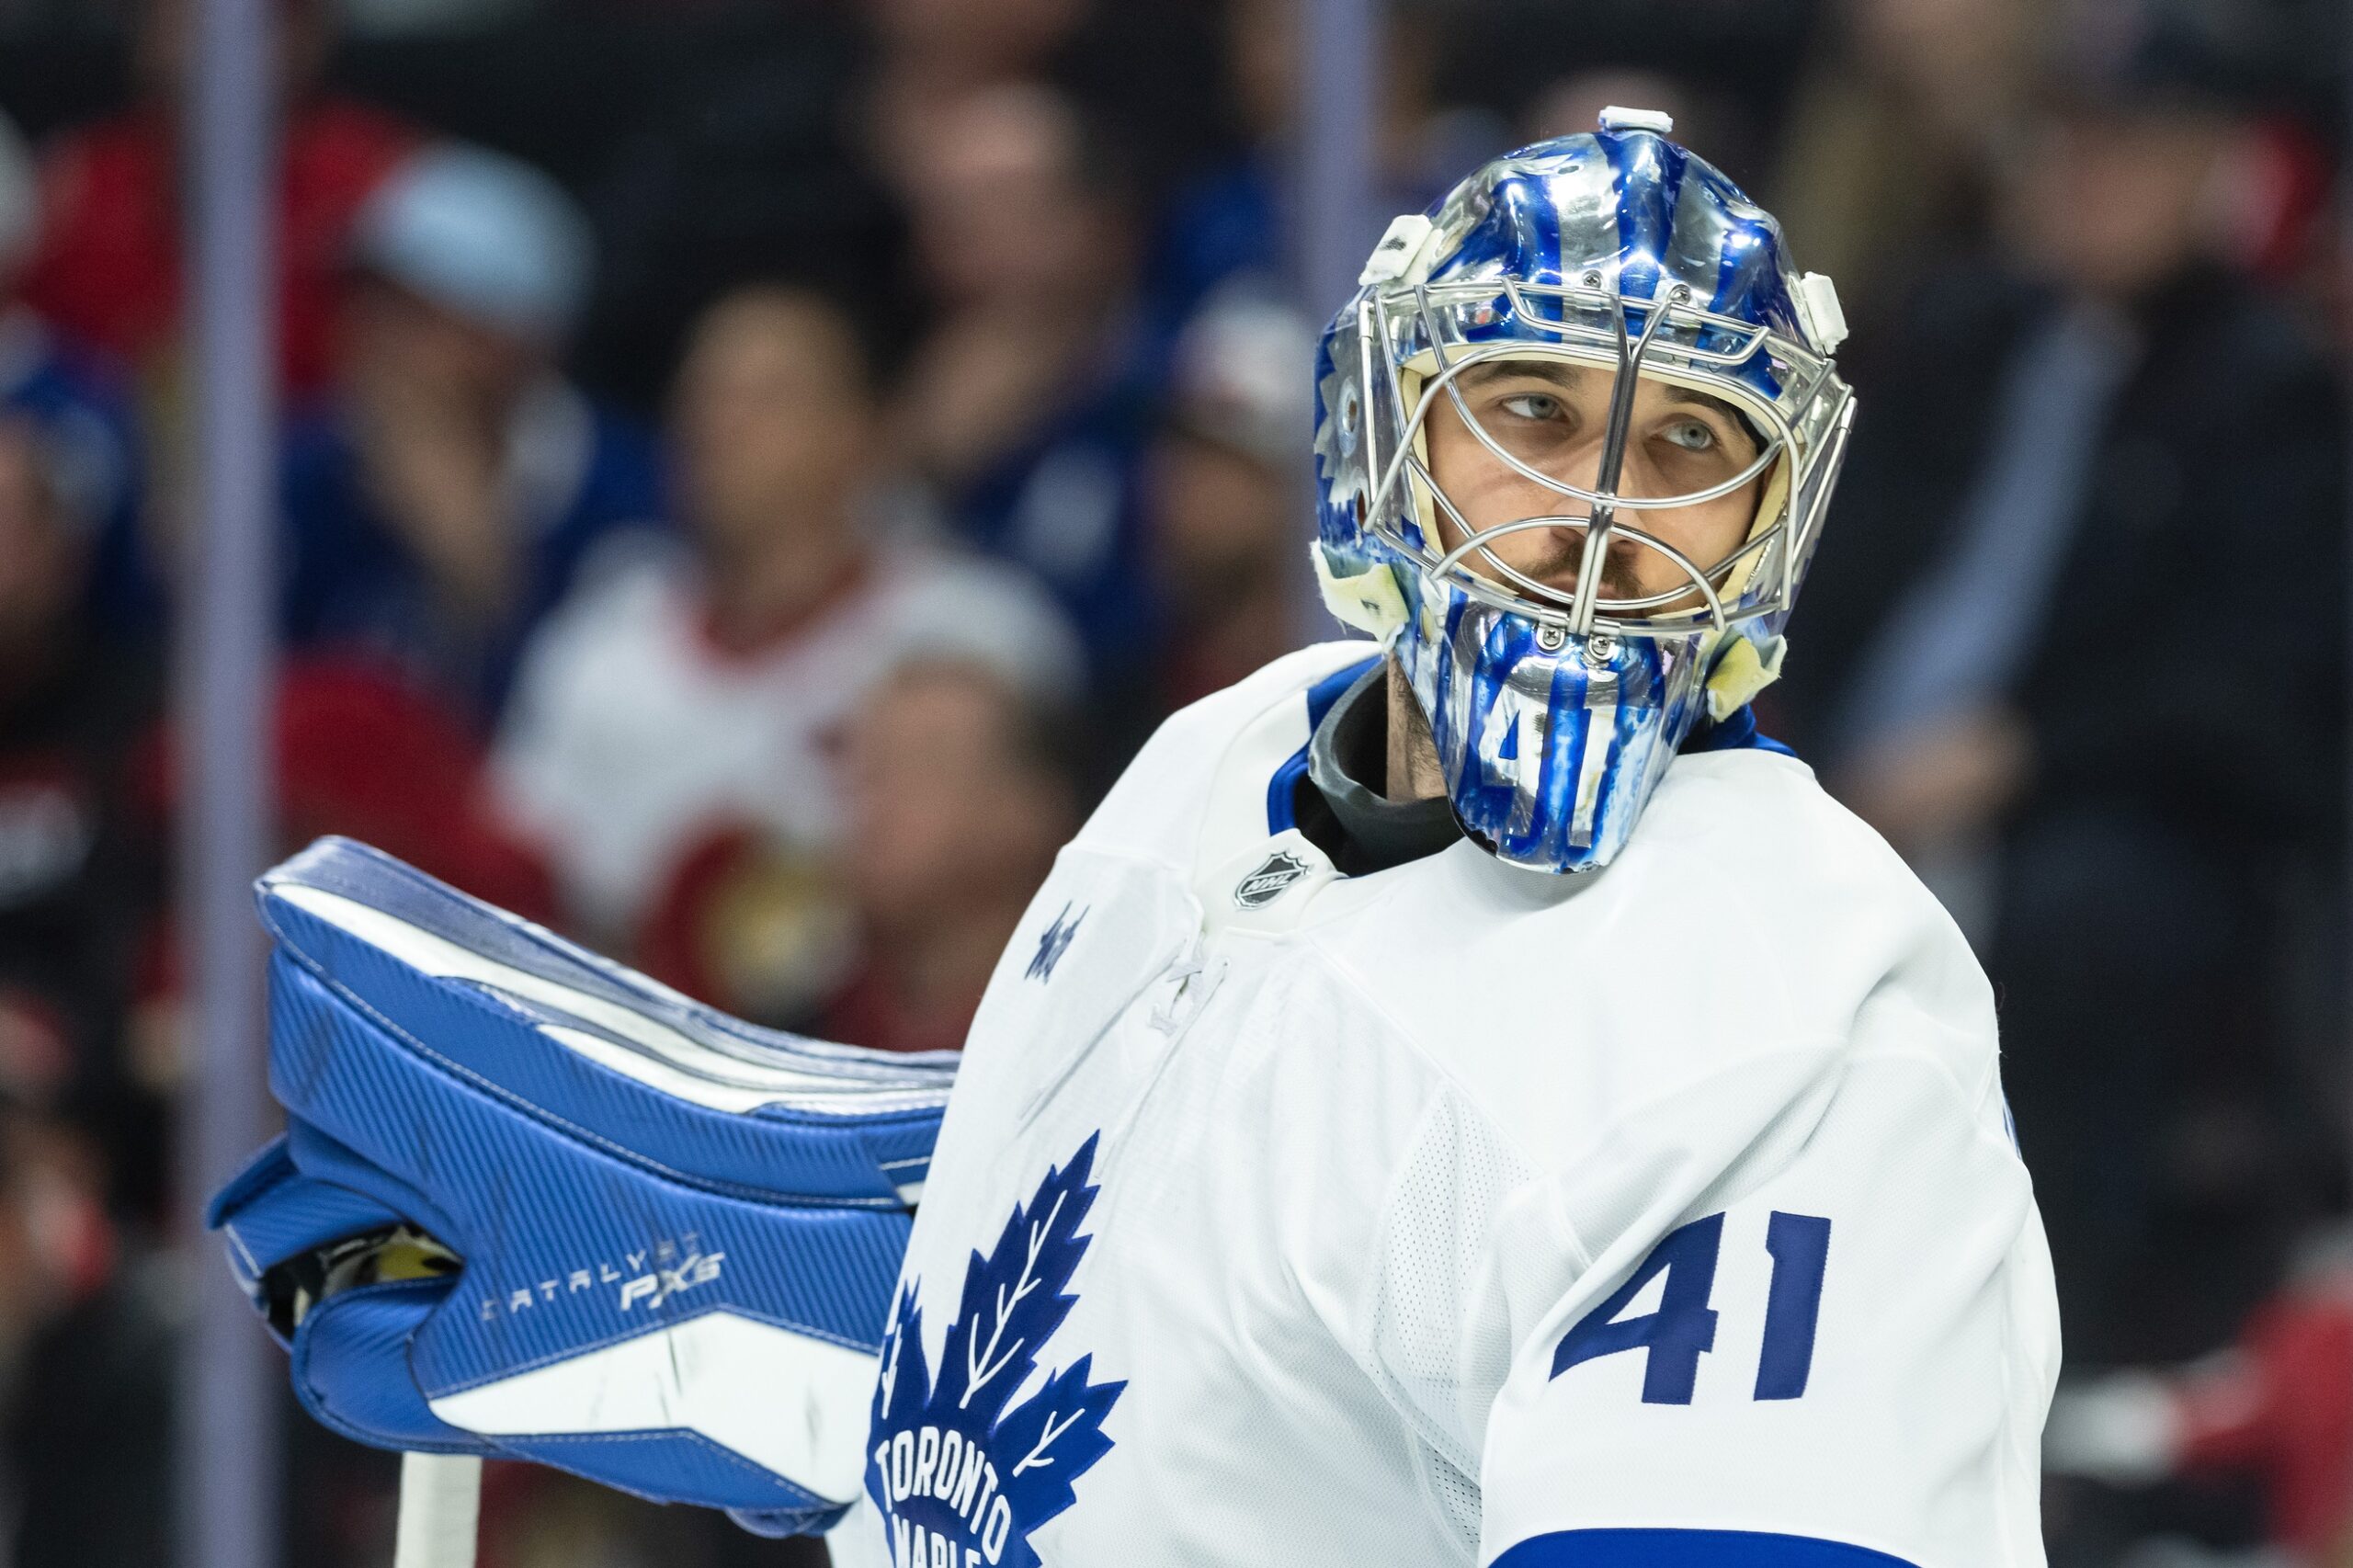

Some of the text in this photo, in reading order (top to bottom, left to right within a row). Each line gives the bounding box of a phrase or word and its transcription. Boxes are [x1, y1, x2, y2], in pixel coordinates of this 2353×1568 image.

[1478, 684, 1620, 849] 41
[1242, 873, 1293, 893] NHL
[1548, 1210, 1832, 1406] 41
[874, 1426, 1012, 1566] TORONTO
